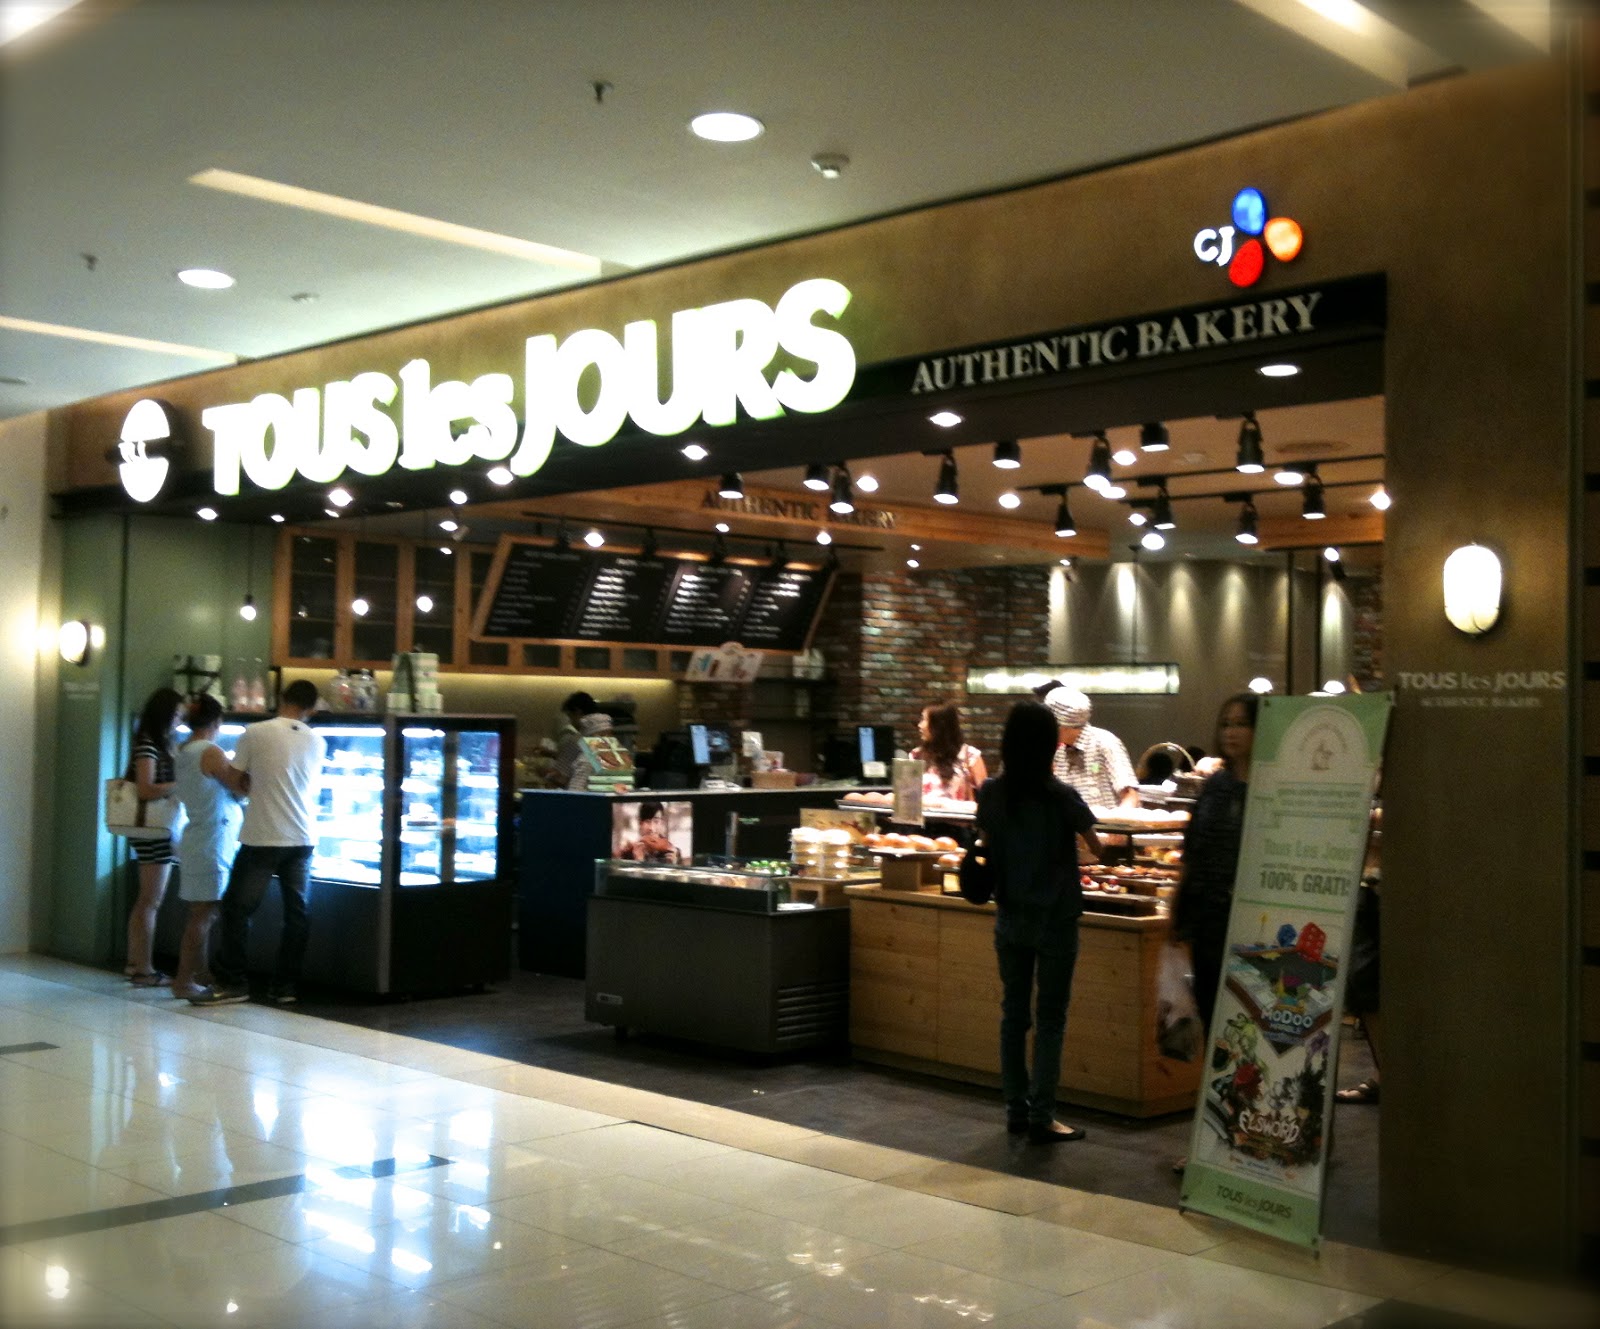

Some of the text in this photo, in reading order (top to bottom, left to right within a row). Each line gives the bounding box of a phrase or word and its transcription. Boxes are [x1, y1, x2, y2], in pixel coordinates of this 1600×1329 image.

[1194, 226, 1236, 266] CJ
[911, 291, 1323, 394] AUTHENTIC BAKERY
[202, 277, 857, 496] TOUS les JOURS
[1398, 671, 1458, 690] TOUS
[1492, 670, 1568, 693] JOURS
[1259, 870, 1298, 892] 100%
[1216, 1184, 1244, 1204] TOUS
[1256, 1199, 1293, 1219] JOURS
